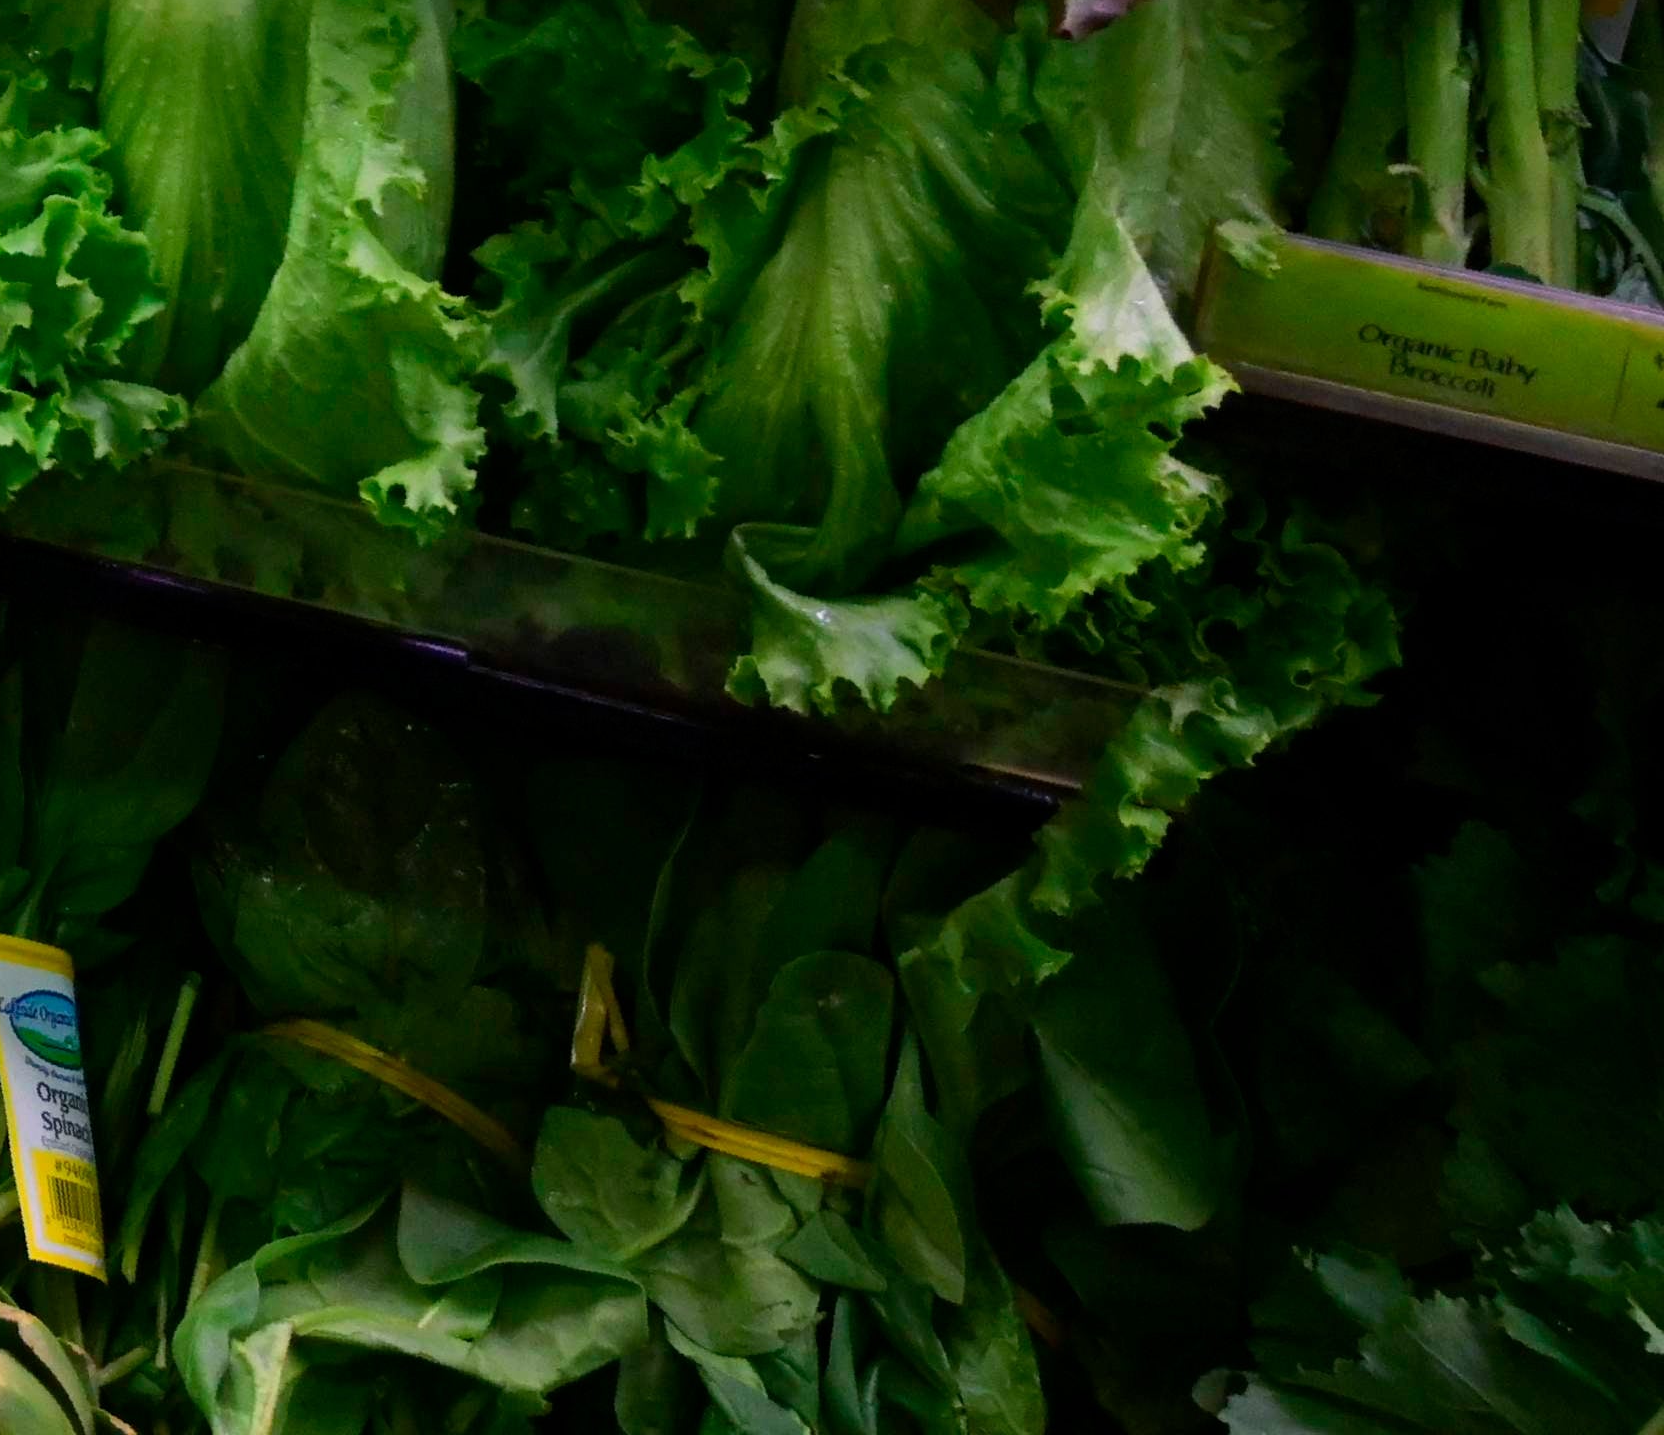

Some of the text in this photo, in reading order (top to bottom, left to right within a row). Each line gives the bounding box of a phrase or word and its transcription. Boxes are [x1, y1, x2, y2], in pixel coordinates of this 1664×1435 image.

[1359, 323, 1538, 385] Organic Baby
[1389, 350, 1496, 398] Broccoli
[36, 1081, 88, 1115] Organi
